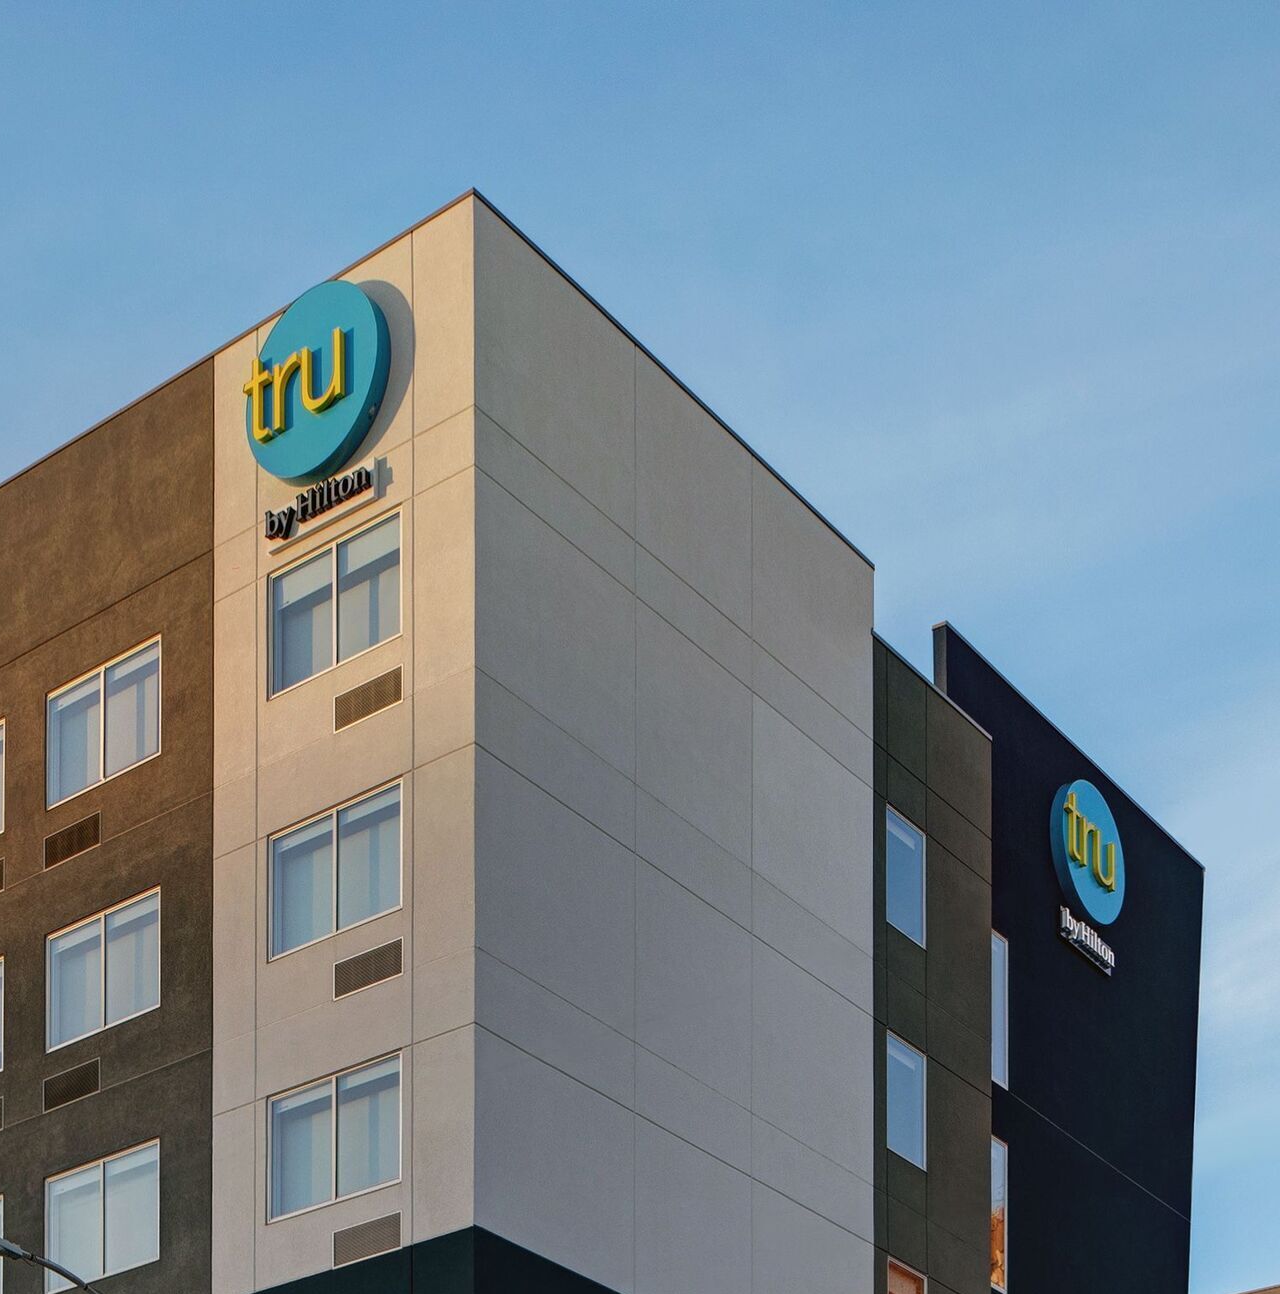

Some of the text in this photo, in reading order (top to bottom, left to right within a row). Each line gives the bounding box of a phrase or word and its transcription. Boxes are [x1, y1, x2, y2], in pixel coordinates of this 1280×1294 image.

[243, 327, 347, 445] tru
[265, 465, 373, 541] by Hilton
[1064, 791, 1116, 893] tru
[1066, 906, 1116, 968] by Hilton
